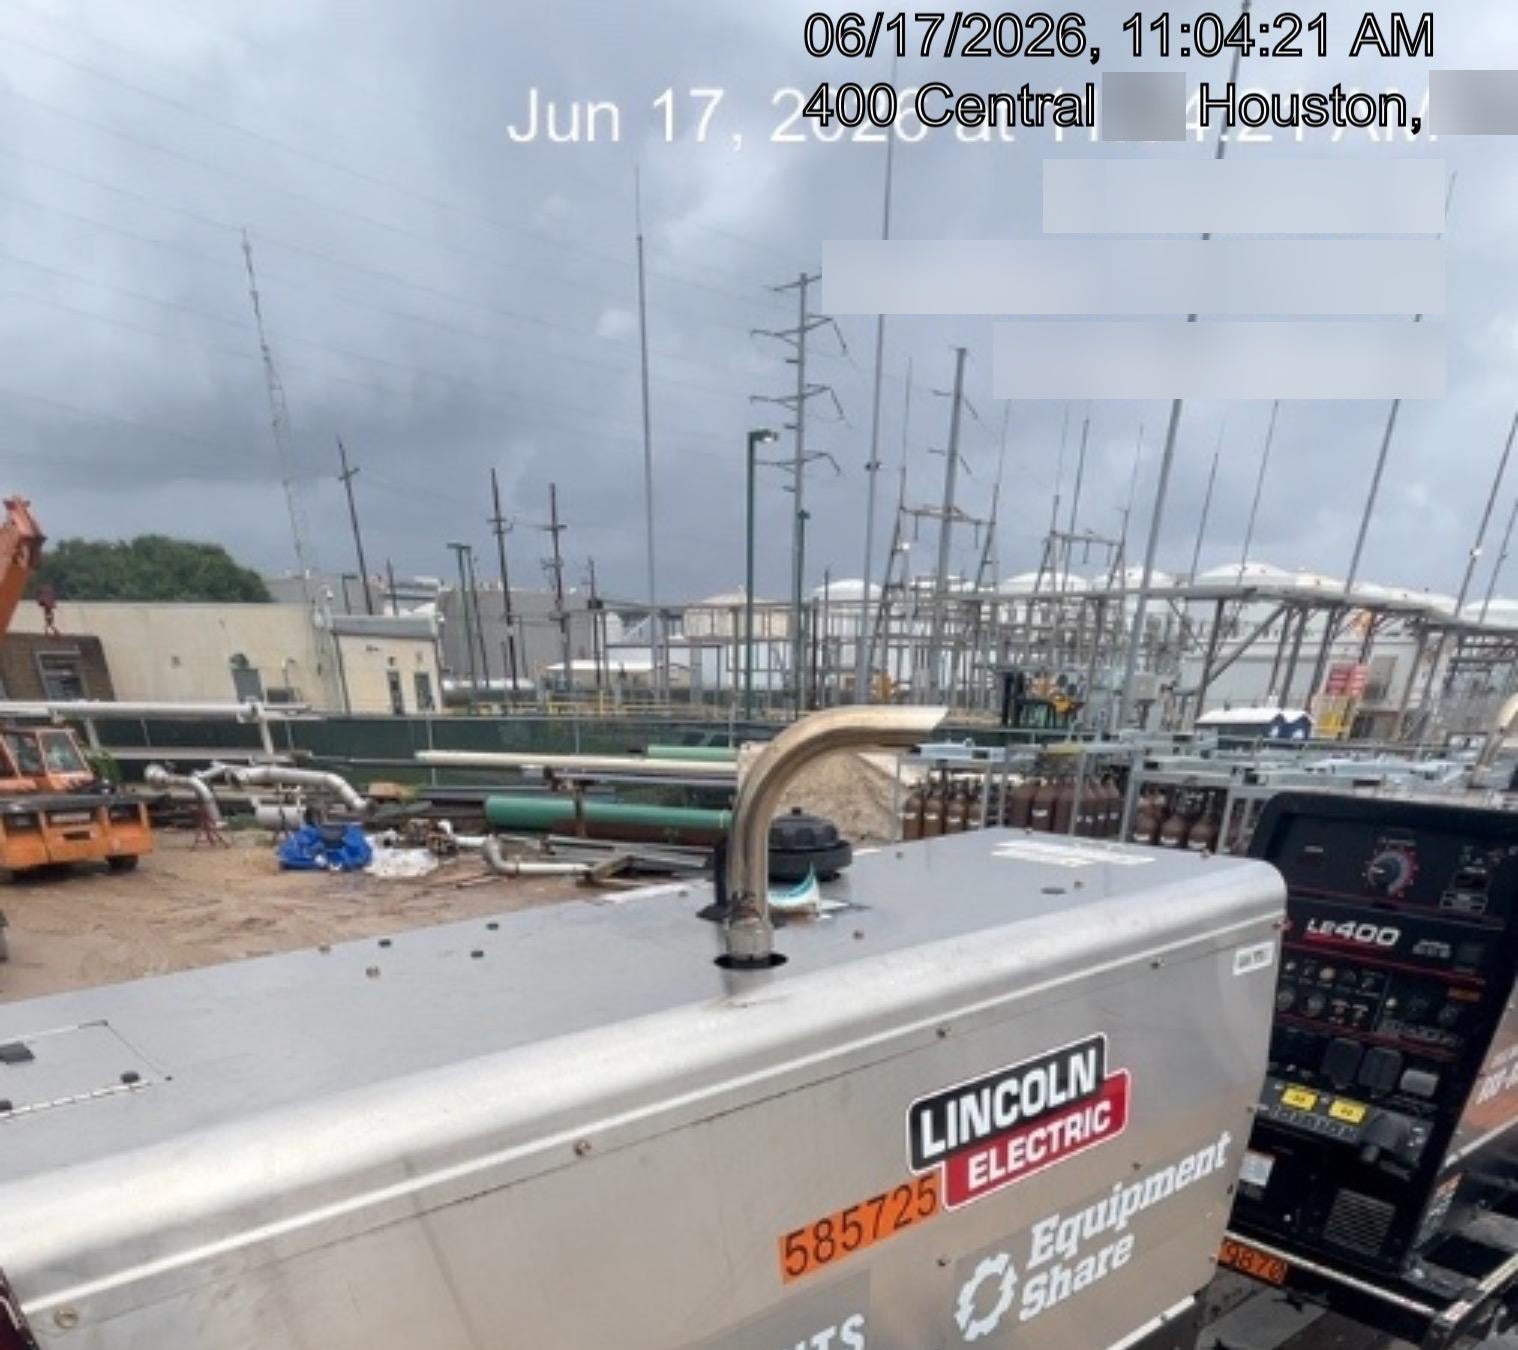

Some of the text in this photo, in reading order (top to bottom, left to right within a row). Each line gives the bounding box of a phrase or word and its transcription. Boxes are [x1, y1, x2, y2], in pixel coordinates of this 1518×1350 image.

[919, 1048, 1098, 1159] LINCOLN
[967, 1101, 1112, 1190] ELECTRIC
[782, 1175, 938, 1278] 585725
[1026, 1130, 1232, 1267] Equipment
[1019, 1233, 1134, 1322] Share
